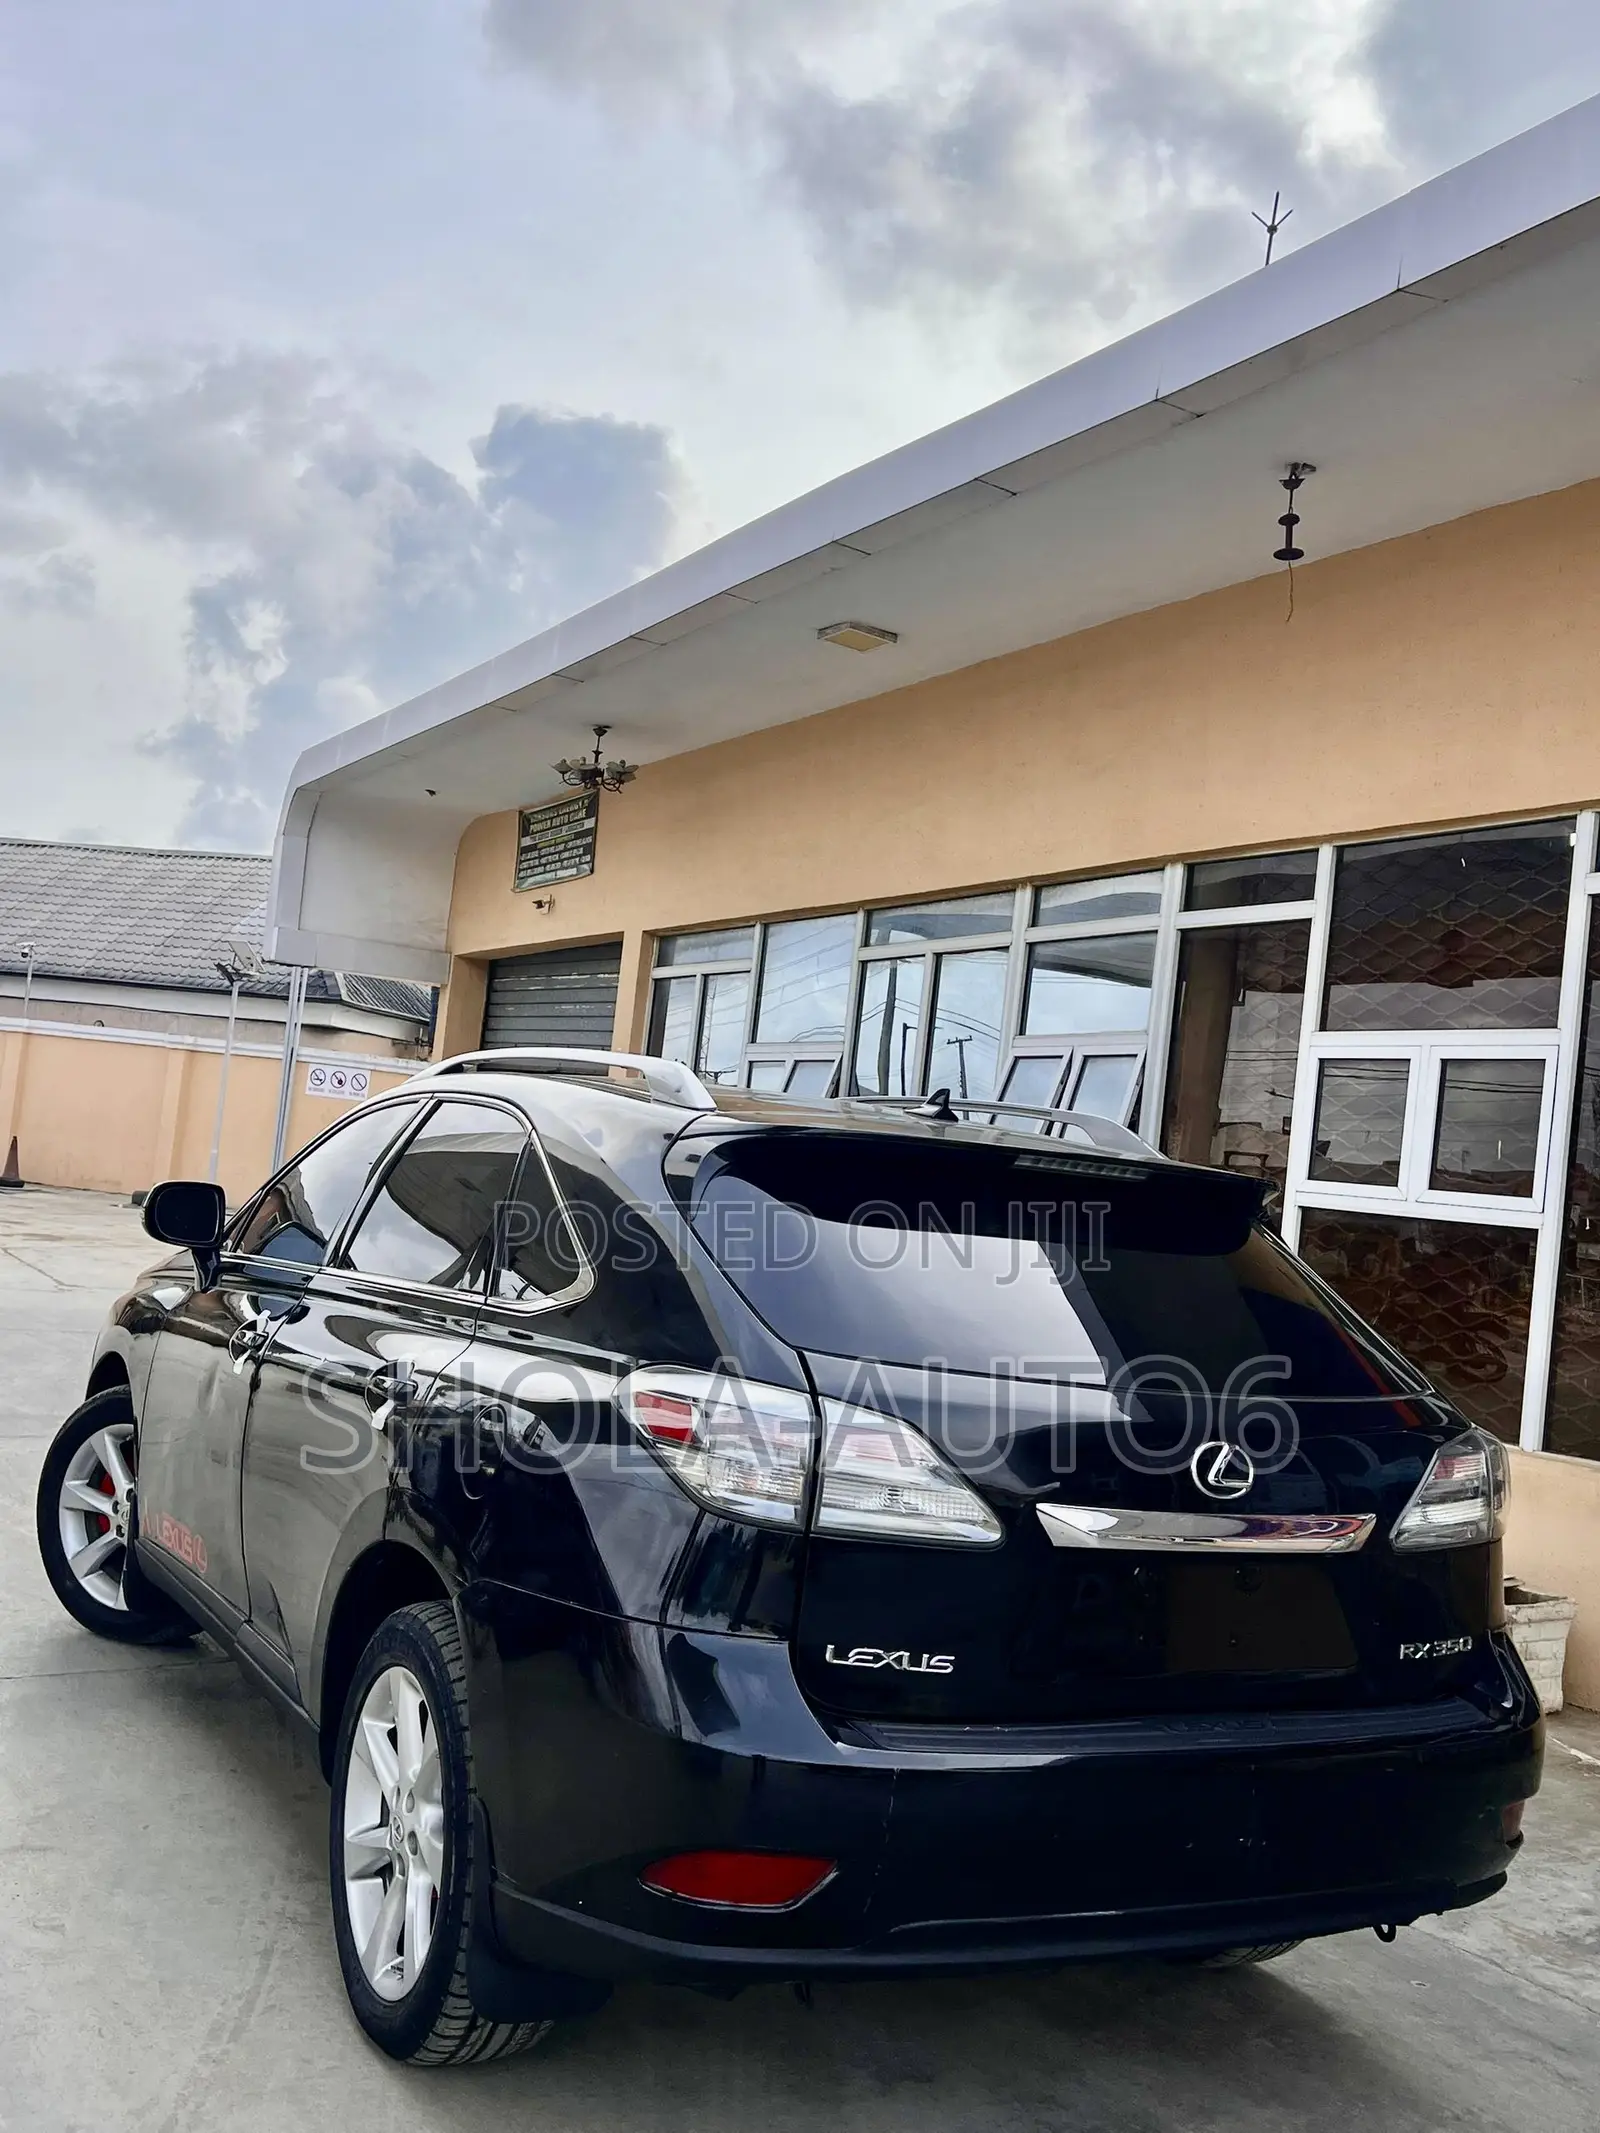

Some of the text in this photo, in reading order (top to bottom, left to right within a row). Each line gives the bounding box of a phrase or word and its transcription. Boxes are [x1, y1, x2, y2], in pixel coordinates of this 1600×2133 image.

[552, 815, 569, 827] AUTO
[156, 1514, 194, 1565] LEXUS
[825, 1644, 955, 1673] LEXUS
